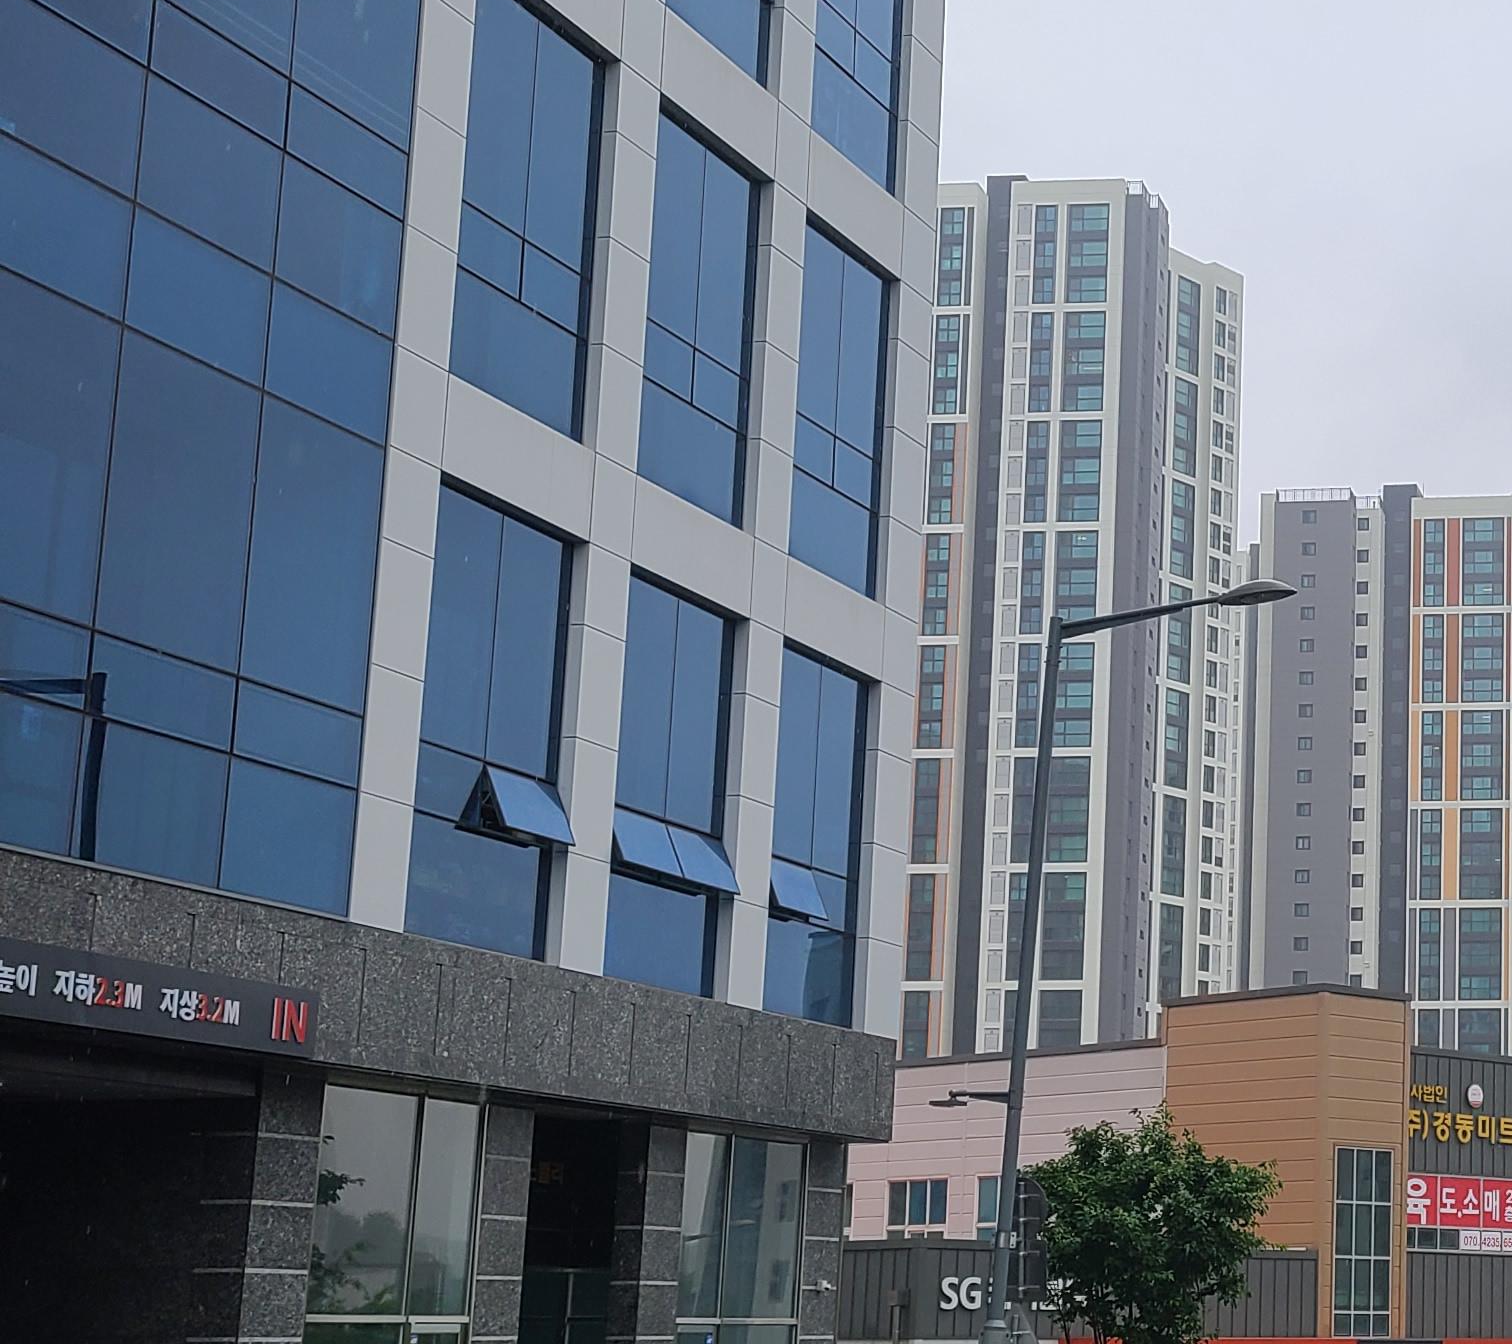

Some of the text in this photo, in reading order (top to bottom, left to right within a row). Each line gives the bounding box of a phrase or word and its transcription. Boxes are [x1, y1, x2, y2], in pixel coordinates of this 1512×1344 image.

[53, 970, 142, 1010] 지하2.3M
[160, 987, 241, 1026] 지상3.2M
[271, 997, 309, 1043] IN
[1411, 1085, 1447, 1104] 사법인
